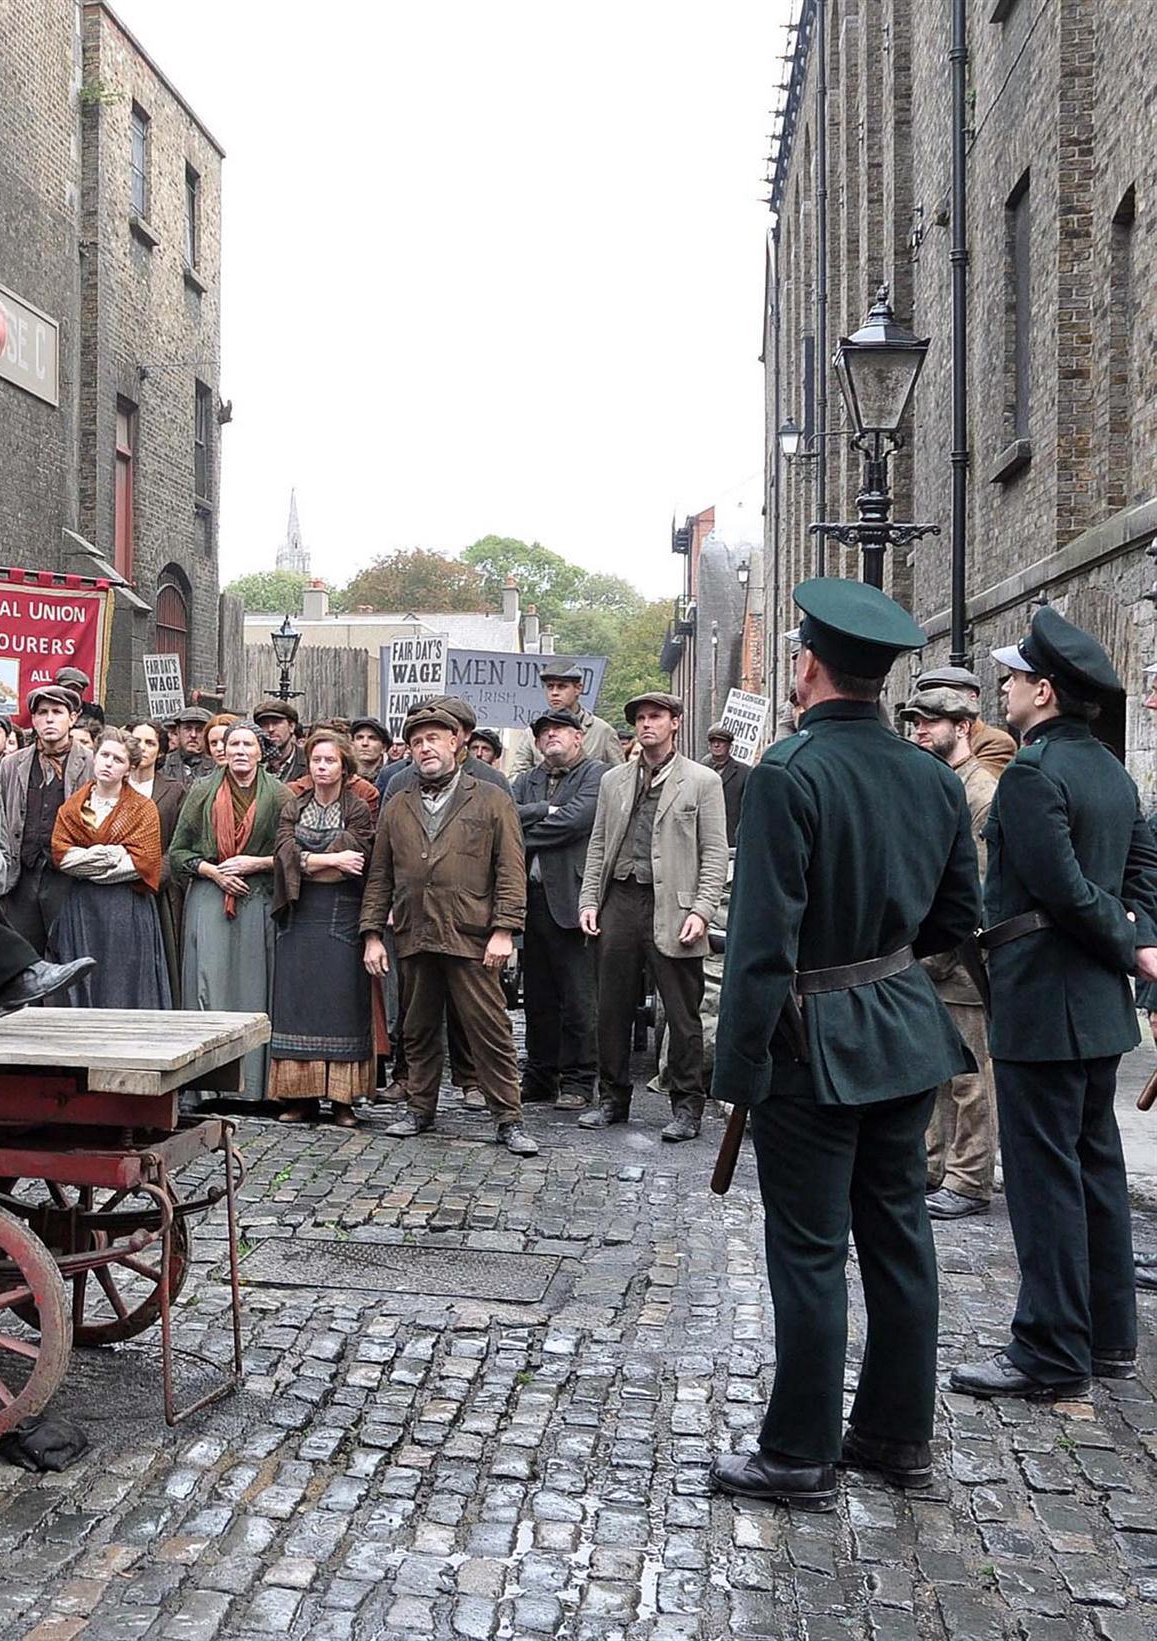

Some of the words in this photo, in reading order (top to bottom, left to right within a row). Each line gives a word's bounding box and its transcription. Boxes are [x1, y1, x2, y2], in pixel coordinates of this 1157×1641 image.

[29, 601, 85, 622] UNION
[393, 642, 413, 661] FAIR
[415, 639, 442, 660] DAY'S
[31, 670, 53, 682] ALL
[392, 663, 442, 683] WAGE
[516, 661, 594, 696] UND
[148, 676, 180, 691] WAGE
[389, 694, 409, 714] FAIR
[732, 690, 741, 699] NO
[721, 716, 759, 742] RIGHTS
